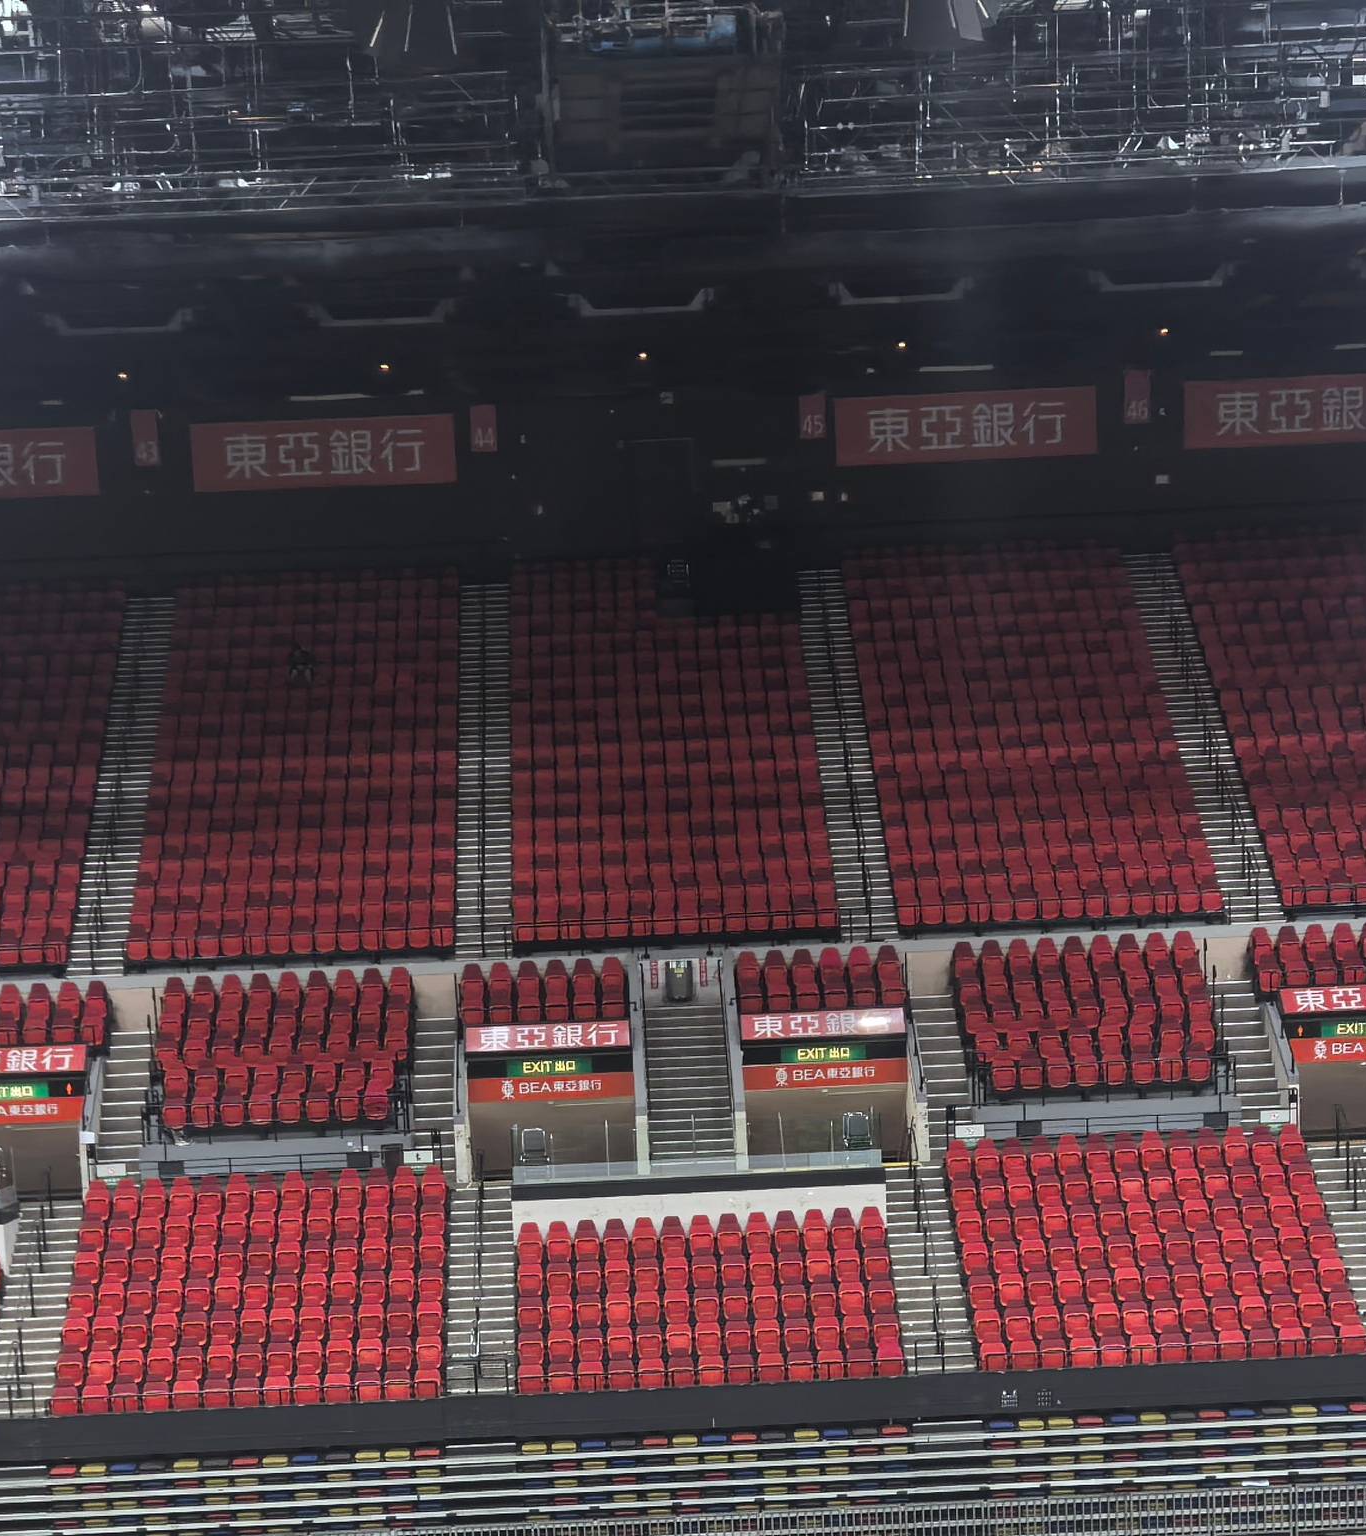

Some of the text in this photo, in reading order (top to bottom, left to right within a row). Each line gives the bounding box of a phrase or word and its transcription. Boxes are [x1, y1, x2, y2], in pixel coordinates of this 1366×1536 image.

[867, 401, 1068, 453] 東亞銀行
[222, 429, 426, 480] 東亞銀行
[1337, 1023, 1366, 1035] EXIT
[479, 1023, 619, 1050] 東亞銀行
[797, 1047, 850, 1060] EXIT 出口
[1332, 1043, 1363, 1055] BEA
[523, 1060, 575, 1074] EXIT 出口
[792, 1066, 875, 1081] BEA 東亞銀行
[10, 1086, 33, 1098] 出口
[519, 1080, 602, 1094] BEA 東亞銀行
